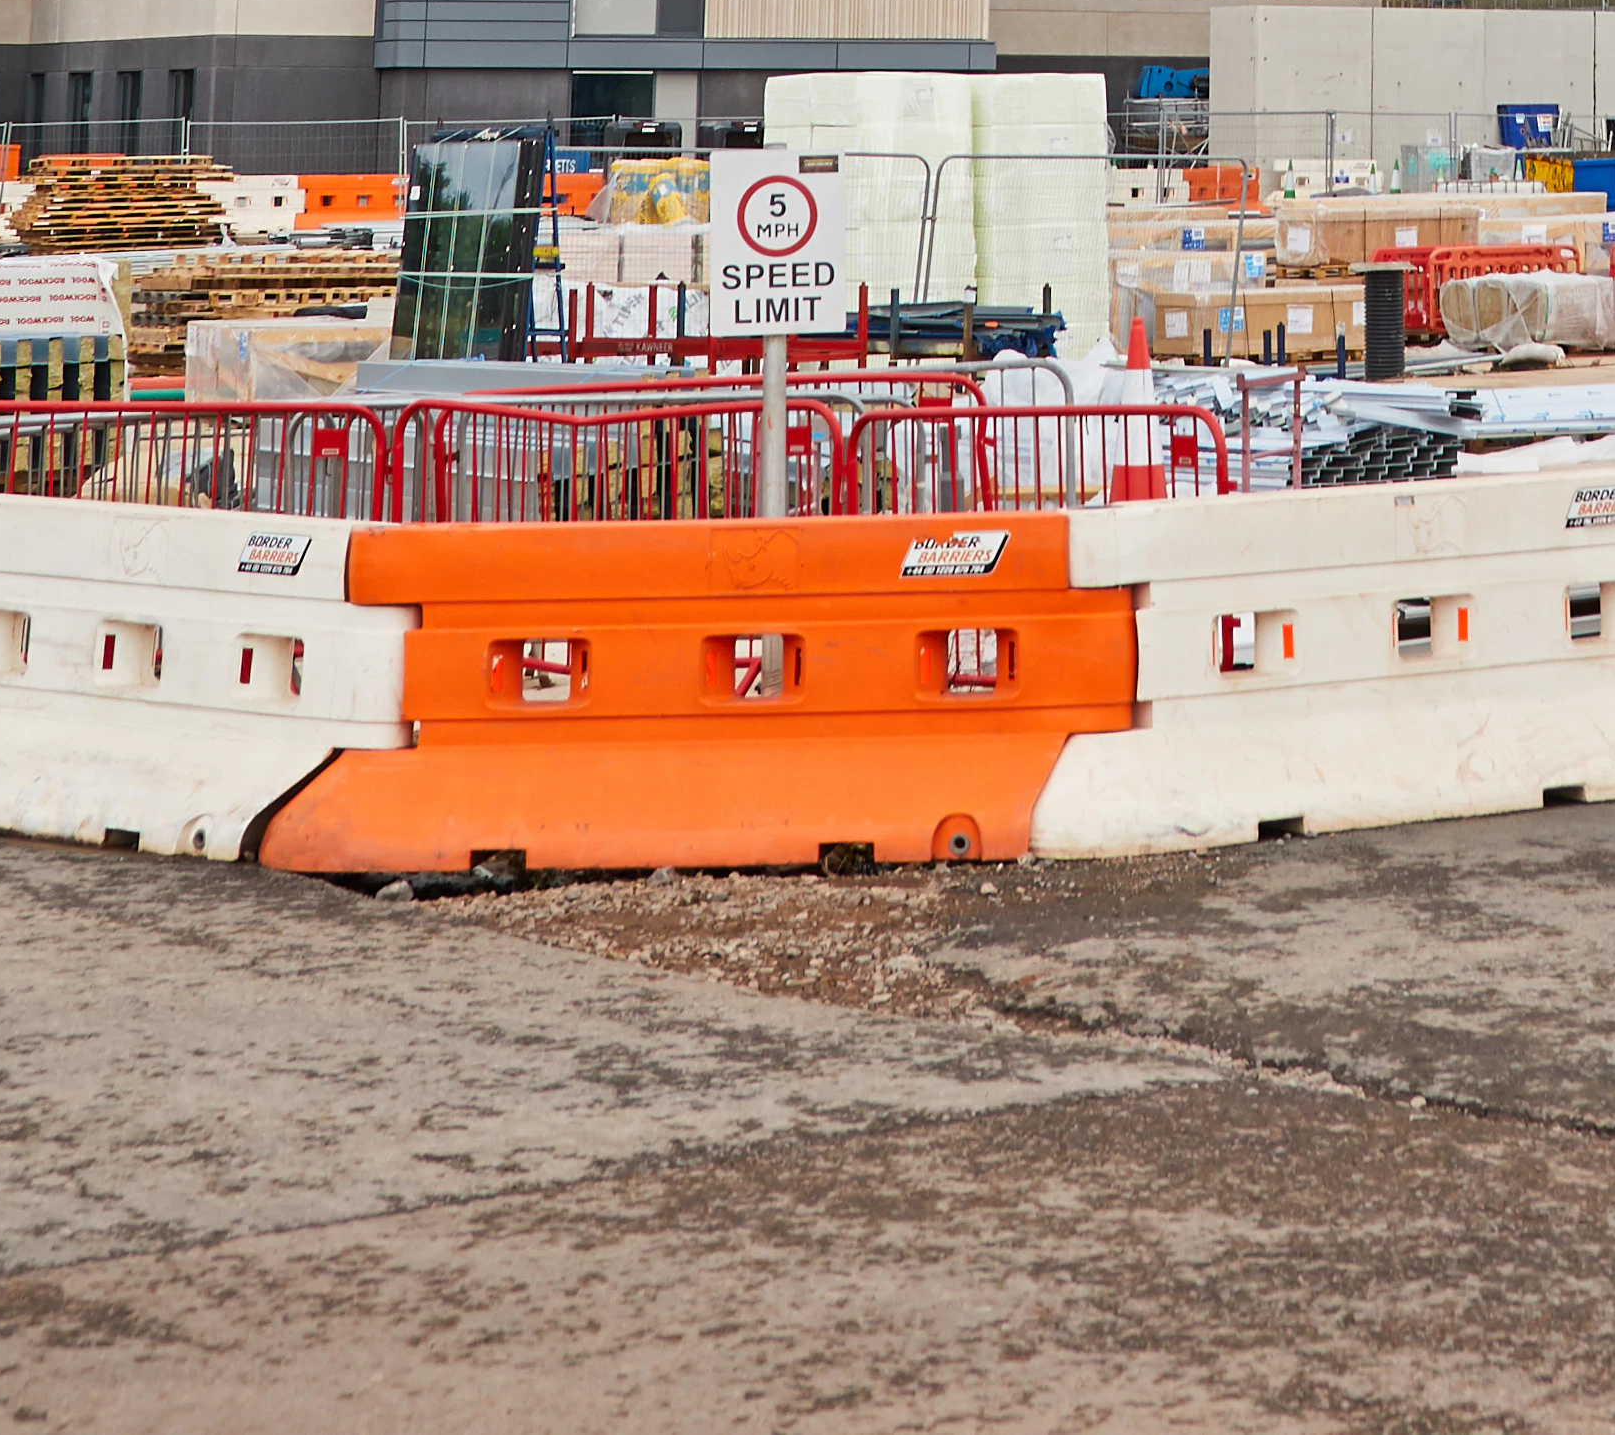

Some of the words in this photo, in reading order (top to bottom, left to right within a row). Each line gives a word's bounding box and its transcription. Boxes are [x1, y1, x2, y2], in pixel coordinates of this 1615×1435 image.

[769, 193, 786, 217] 5
[757, 222, 799, 238] MPH
[722, 261, 835, 290] SPEED
[735, 296, 822, 324] LIMIT
[248, 535, 293, 549] BORDER
[249, 549, 299, 563] BARRIERS
[917, 549, 993, 564] BARRIERS
